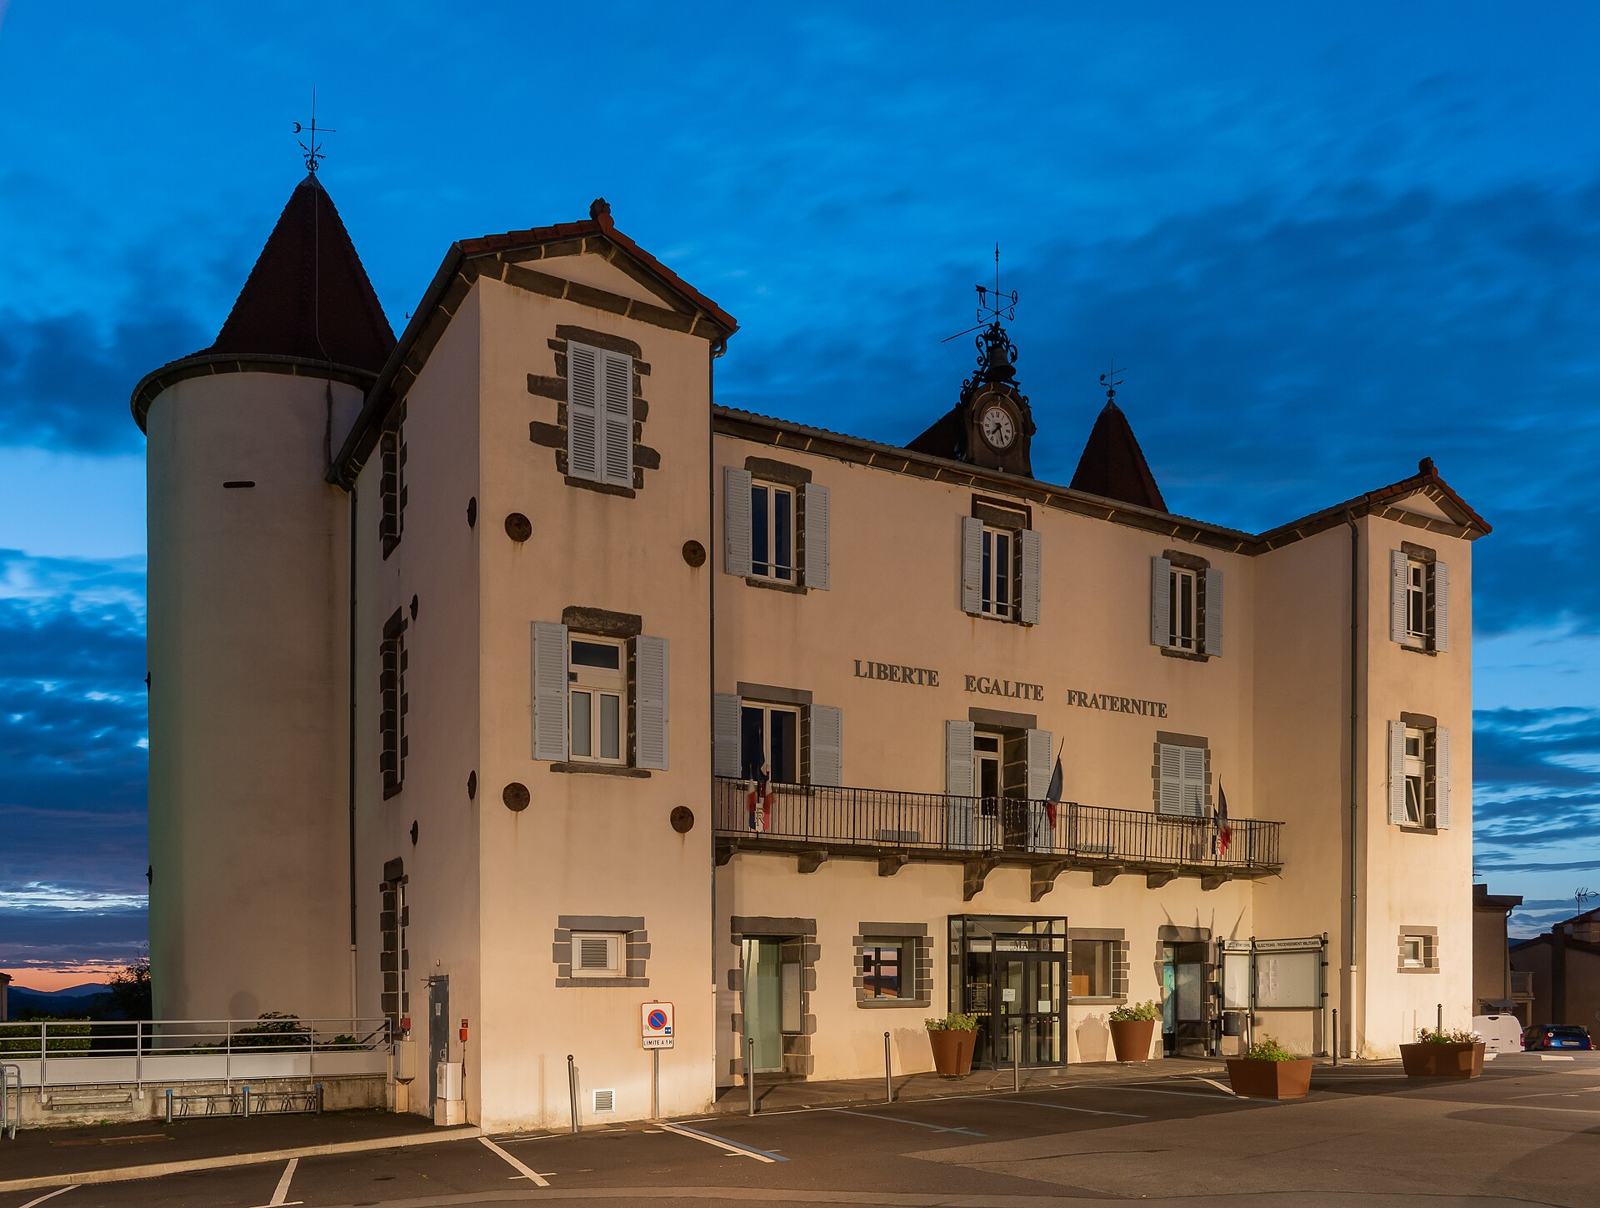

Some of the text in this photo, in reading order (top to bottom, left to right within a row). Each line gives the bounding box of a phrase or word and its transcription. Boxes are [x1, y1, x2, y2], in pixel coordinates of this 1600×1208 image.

[854, 660, 1168, 718] LIBERTE EGALITE FRATERNITE
